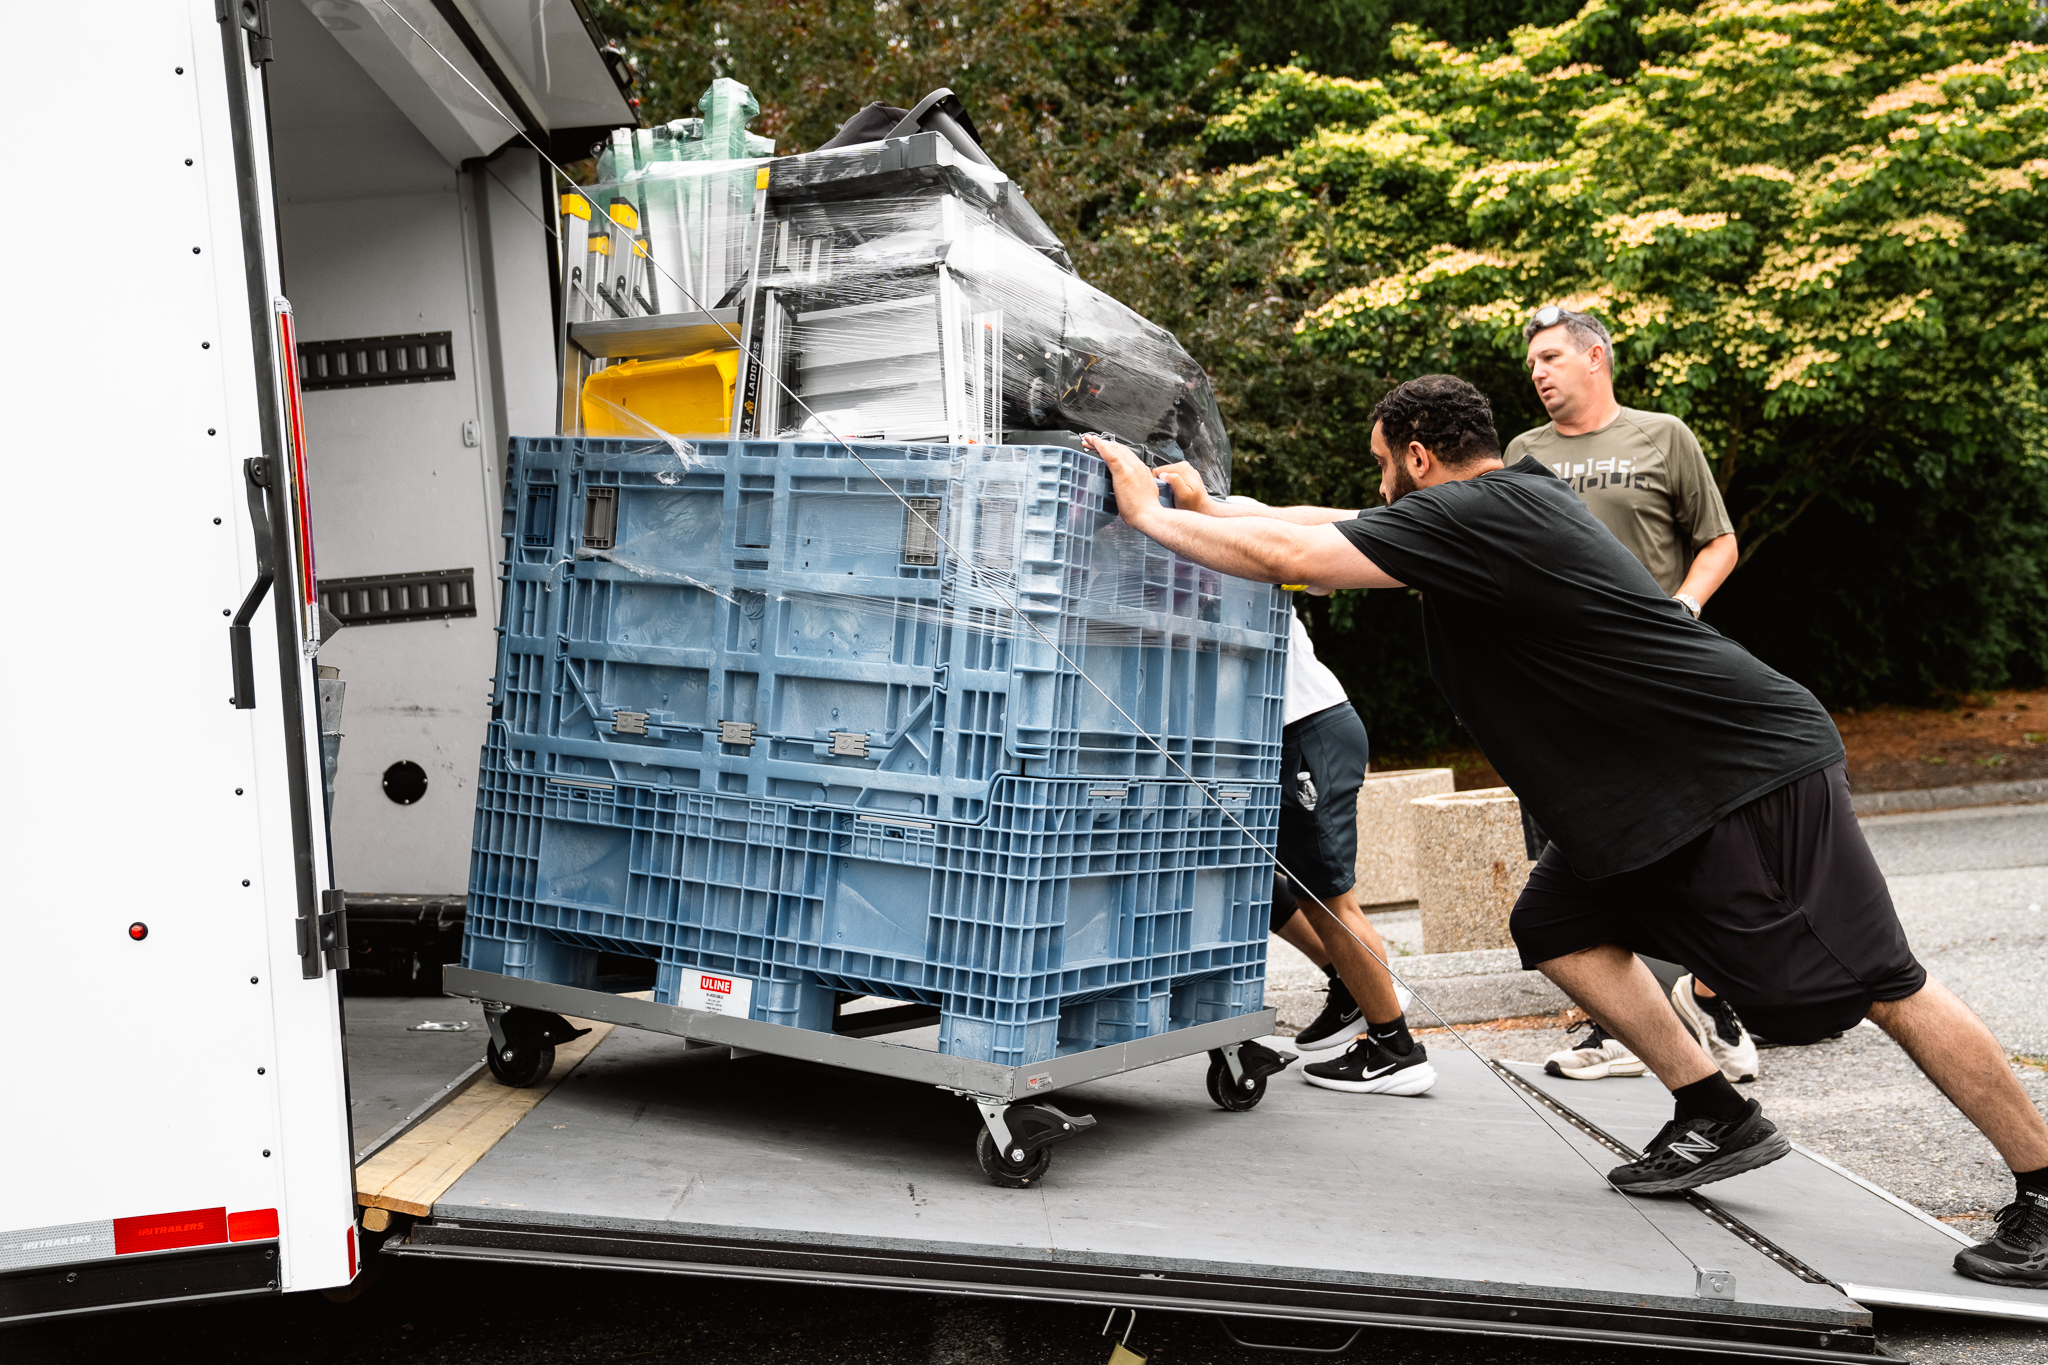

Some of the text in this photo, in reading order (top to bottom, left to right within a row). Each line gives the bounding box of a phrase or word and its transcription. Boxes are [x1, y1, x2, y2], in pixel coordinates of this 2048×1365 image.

[747, 341, 761, 398] LADDERS
[1546, 456, 1638, 479] NDER
[702, 977, 731, 992] ULINE
